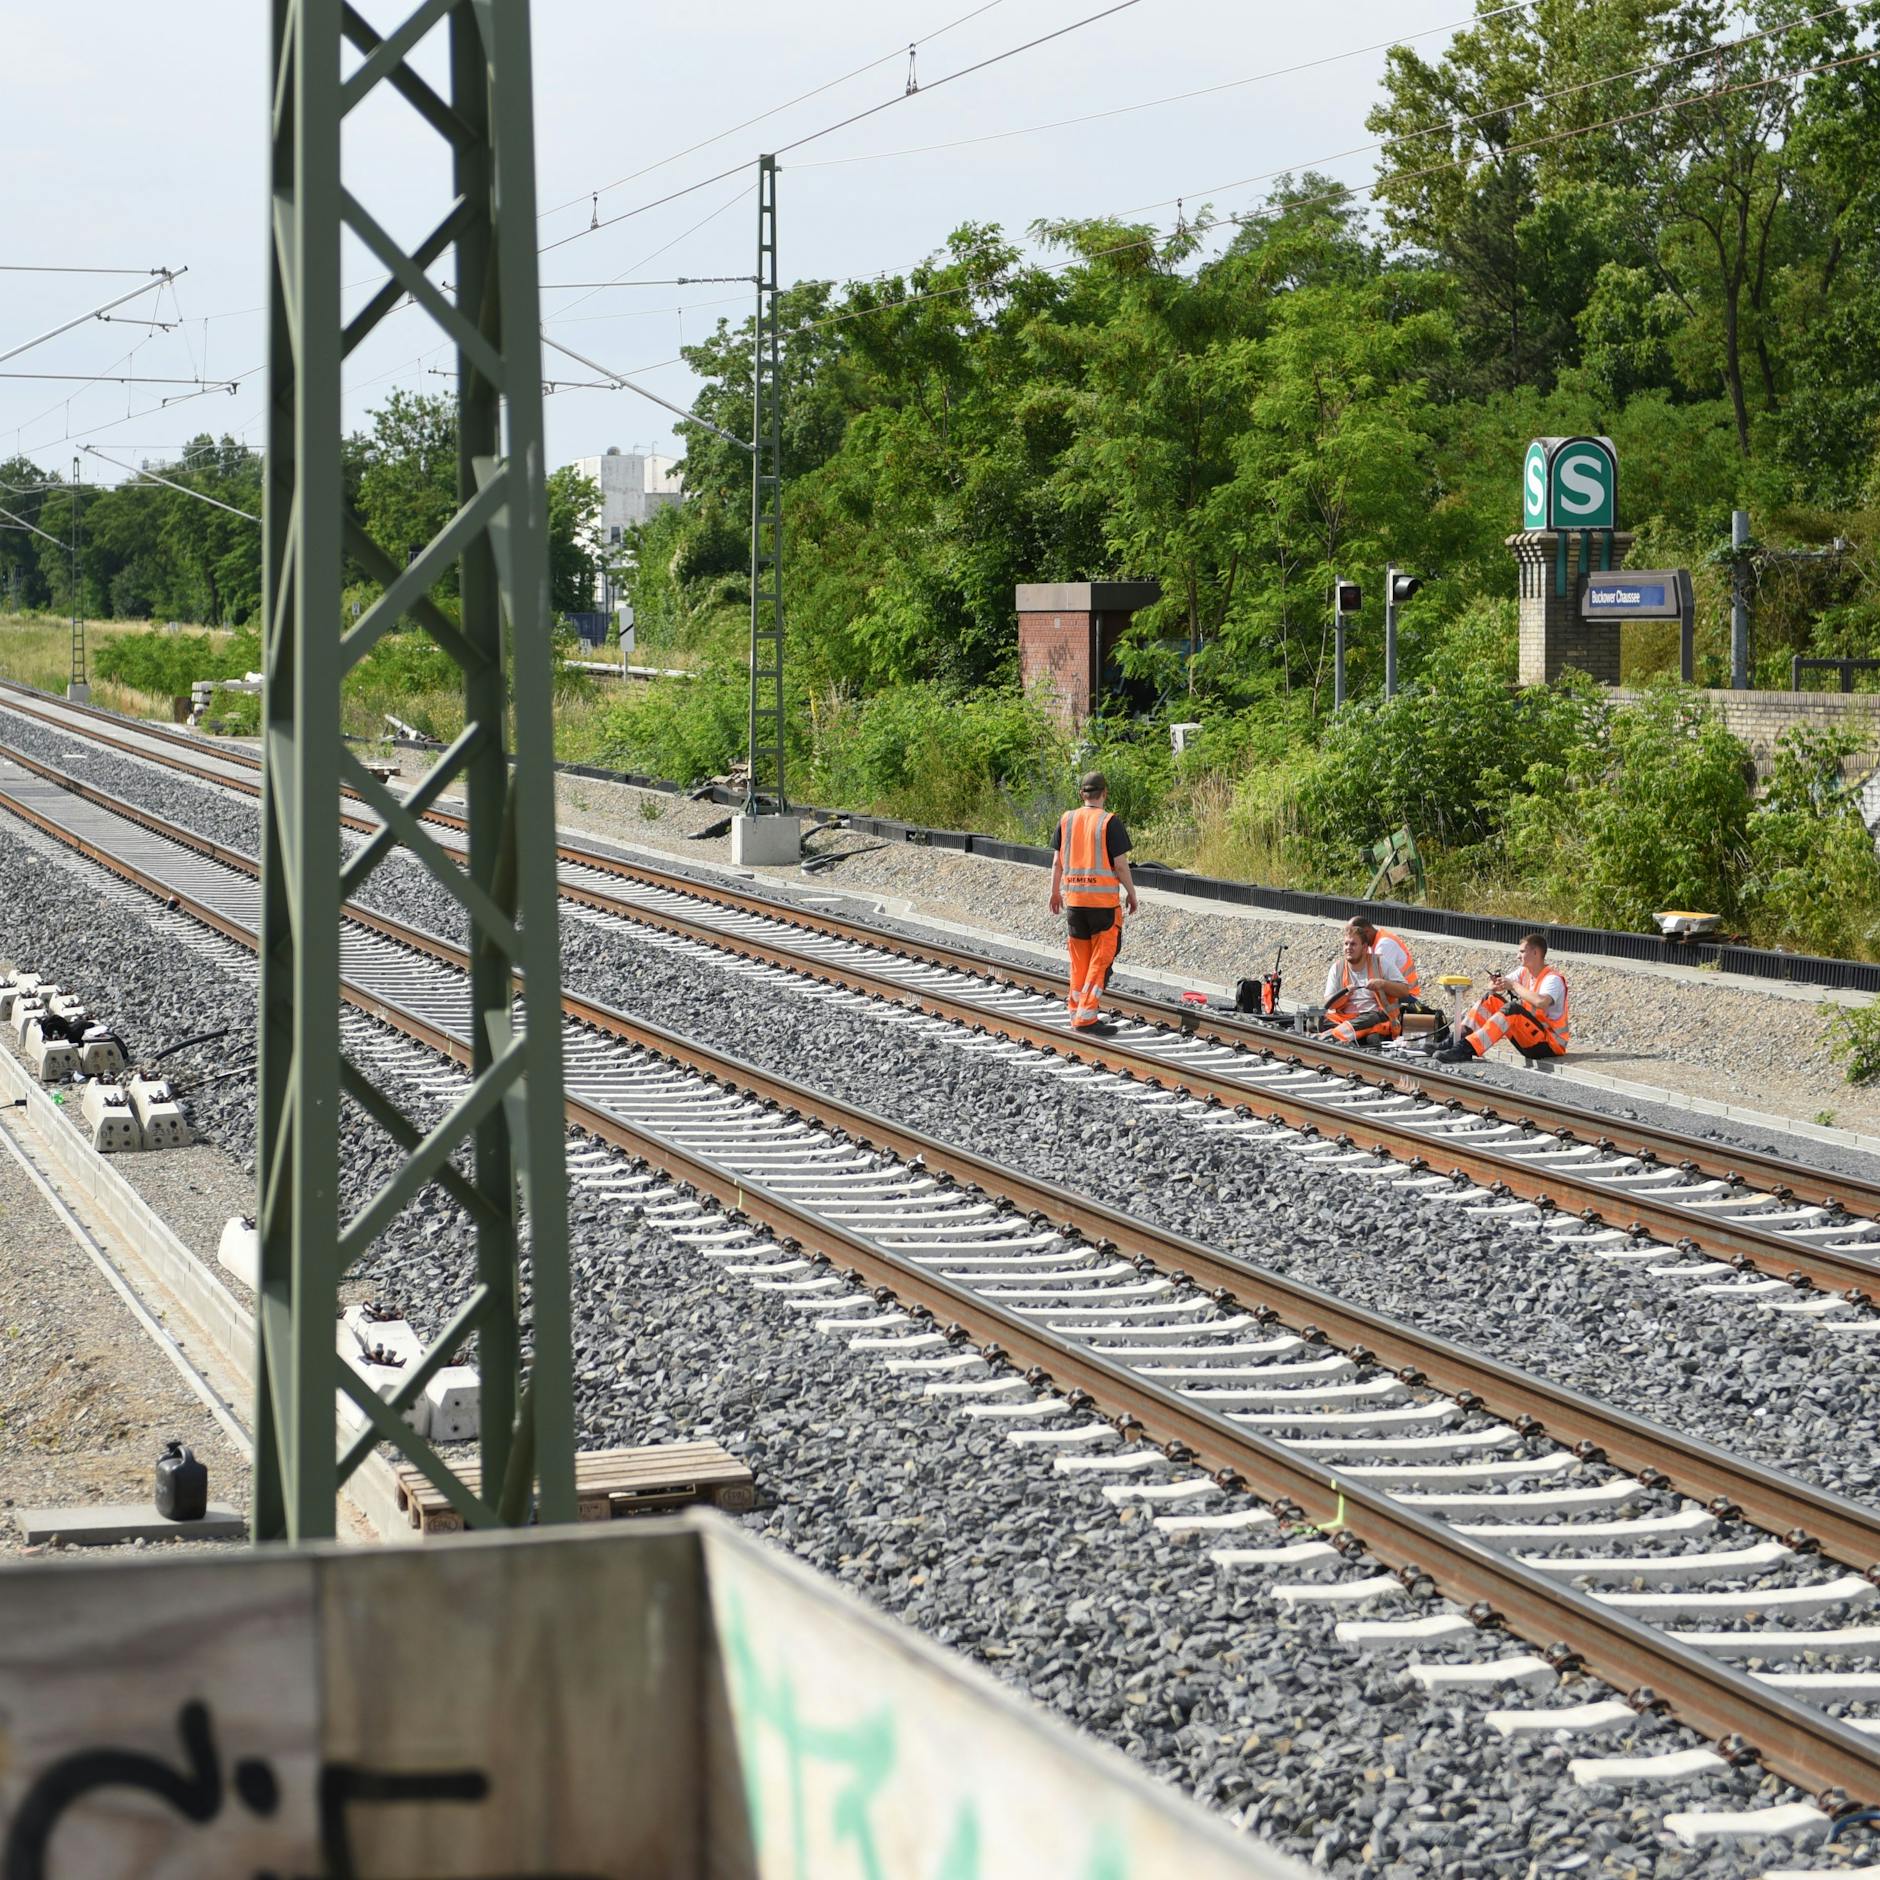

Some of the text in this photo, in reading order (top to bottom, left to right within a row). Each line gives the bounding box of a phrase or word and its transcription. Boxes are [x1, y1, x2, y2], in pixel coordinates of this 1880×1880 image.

[1527, 456, 1543, 516] S
[1560, 455, 1605, 515] S
[1592, 589, 1641, 604] Buckower Chaussee
